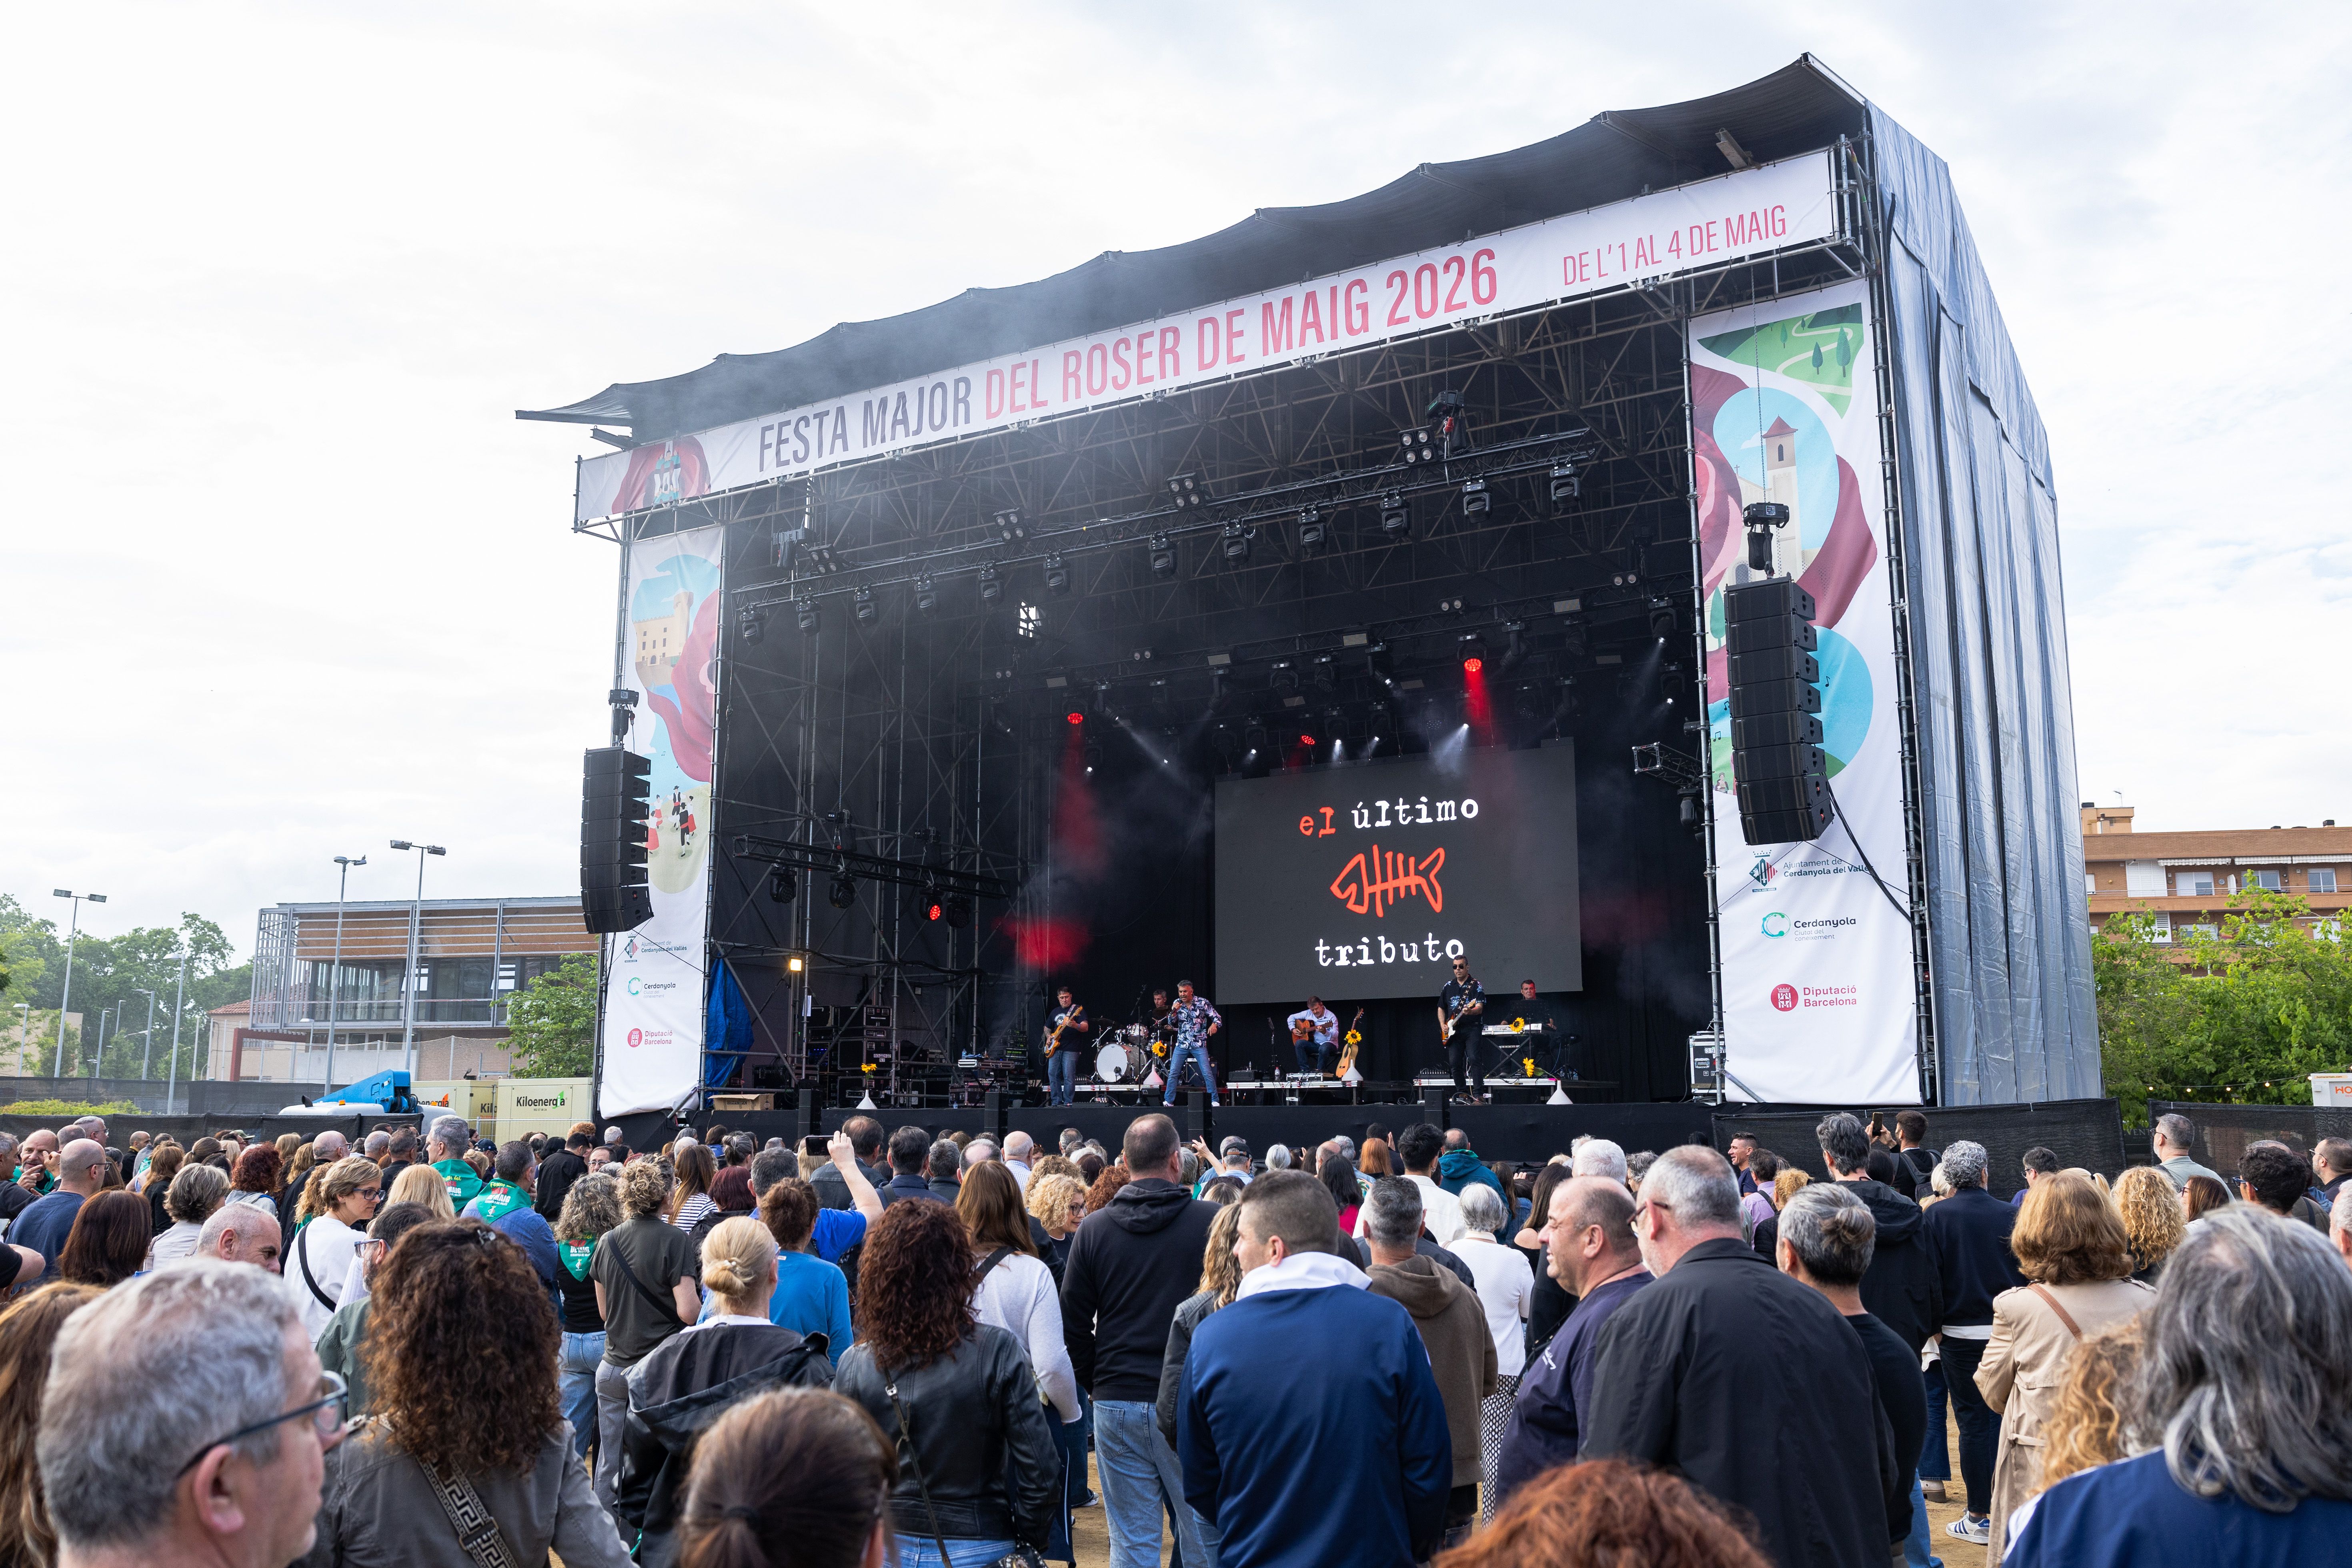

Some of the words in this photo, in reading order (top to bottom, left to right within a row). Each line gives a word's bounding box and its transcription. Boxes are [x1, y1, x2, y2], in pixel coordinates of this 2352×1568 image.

[1563, 251, 1590, 286] DE
[1635, 235, 1662, 269] AL
[1667, 230, 1682, 260] 4
[1689, 221, 1719, 256] DE
[1725, 205, 1787, 248] MAIG
[759, 406, 849, 472] FESTA
[863, 376, 972, 449] MAJOR
[986, 358, 1049, 420] DEL
[1062, 325, 1181, 403] ROSER
[1197, 308, 1245, 372] DE
[1261, 278, 1370, 357] MAIG
[1386, 248, 1498, 328] 2026
[1299, 806, 1336, 838] el
[1351, 796, 1479, 829] último
[1783, 859, 1830, 870] Ajuntament
[1784, 867, 1831, 877] Cerdanyola
[1794, 917, 1856, 928] Cerdanyola
[1315, 932, 1465, 967] tributo
[1804, 985, 1857, 997] Diputació
[1804, 997, 1857, 1007] Barcelona
[516, 1095, 565, 1109] Kiloenergia
